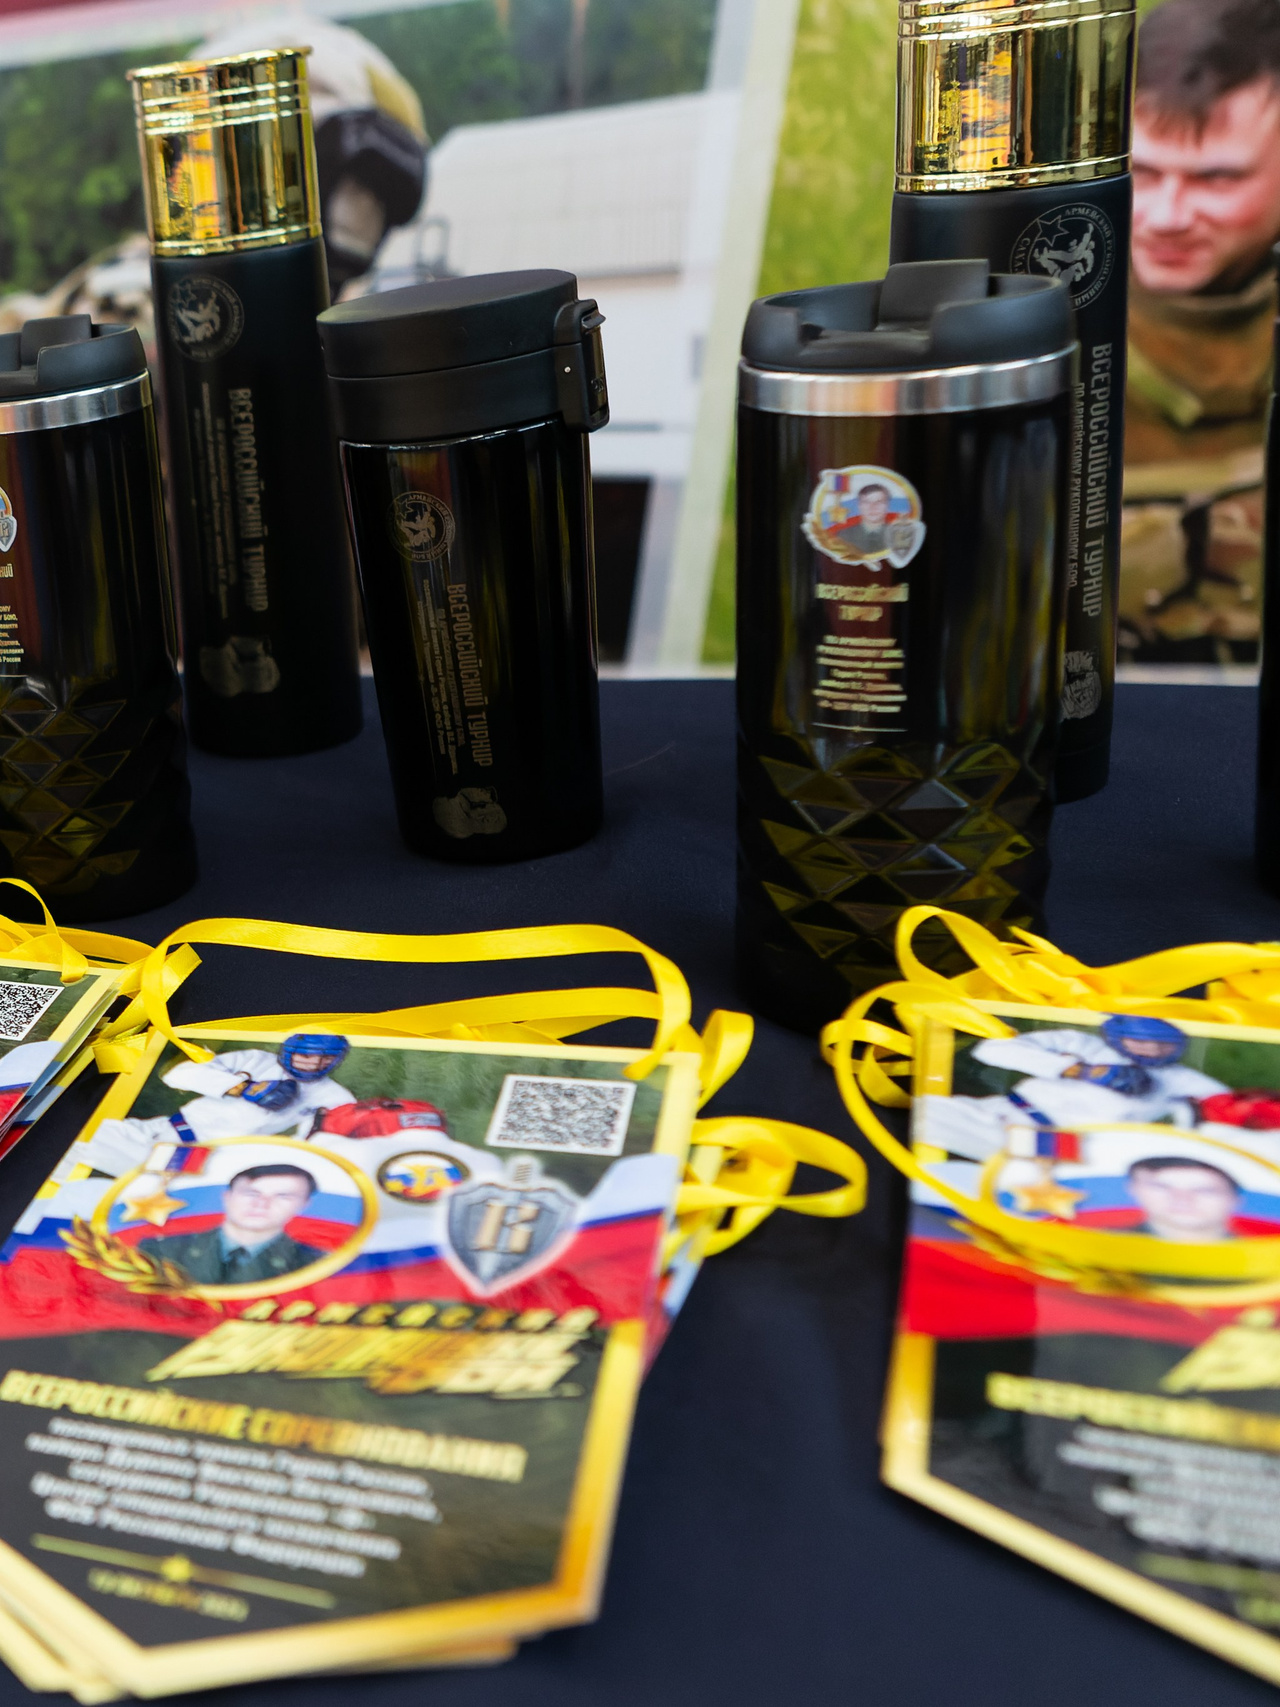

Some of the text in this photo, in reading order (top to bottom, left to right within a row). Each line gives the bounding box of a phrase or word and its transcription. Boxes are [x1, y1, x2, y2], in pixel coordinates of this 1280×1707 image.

[228, 387, 269, 612] ВСЕРОССИЙСКИЙ ТУРНИР
[1069, 477, 1081, 561] РУКОПАШНОМУ
[1071, 400, 1084, 474] АРМЕЙСКОМУ
[1082, 343, 1113, 617] ВСЕРОССИЙСКИЙ ТУРНИР
[446, 583, 493, 767] ВСЕРОССИЙСКИЙ ТУРНИР
